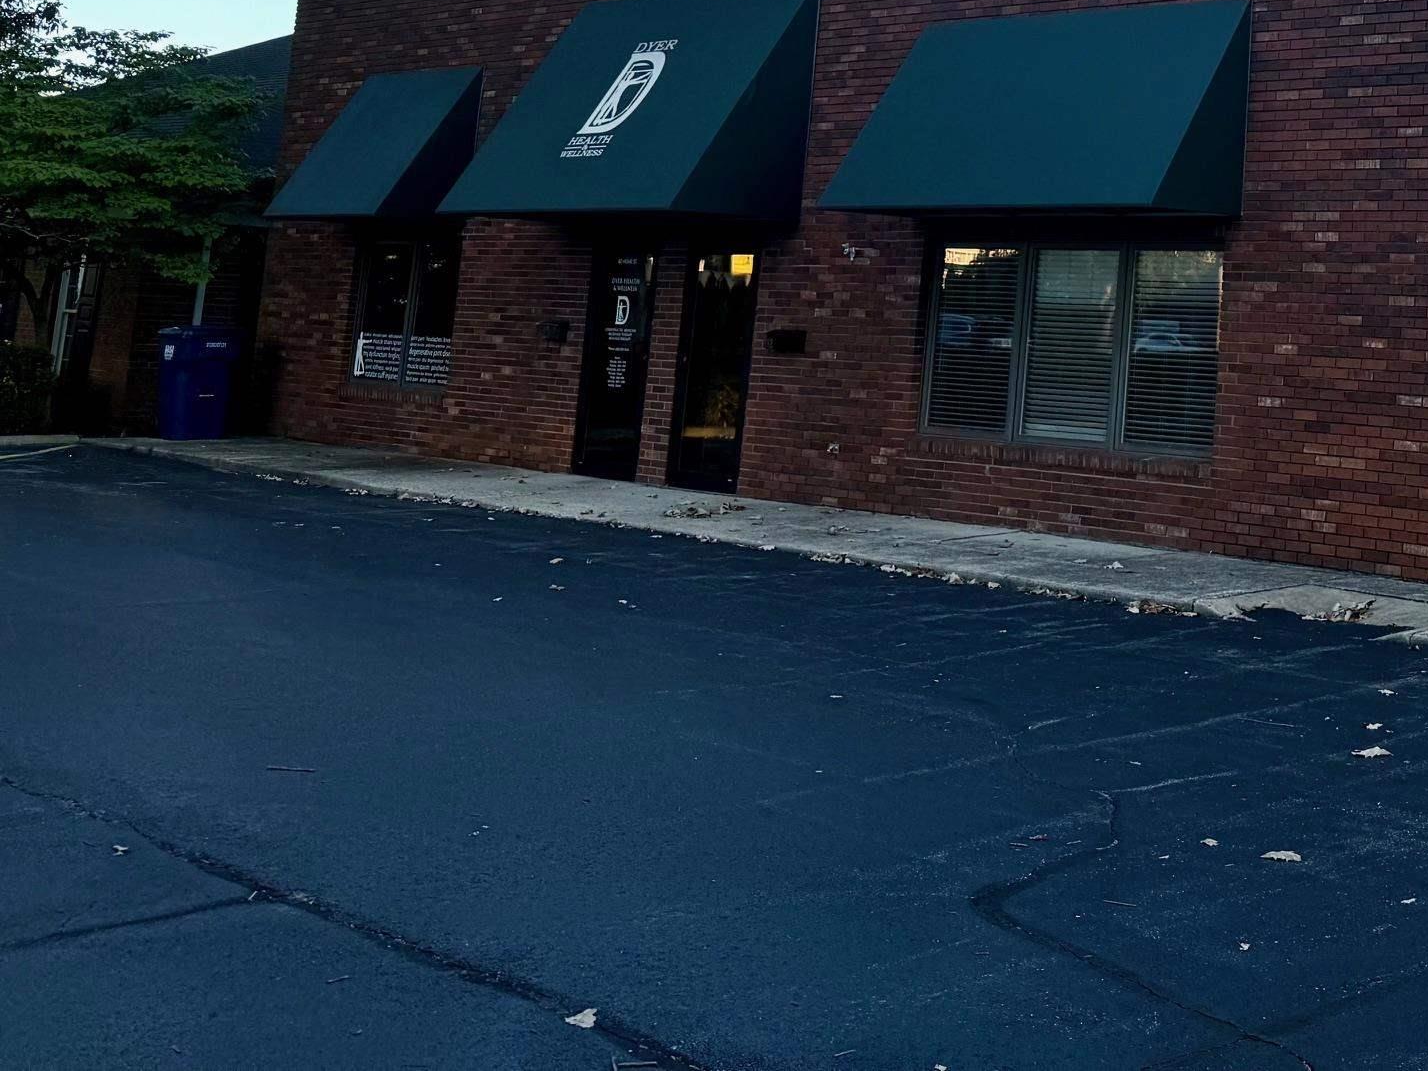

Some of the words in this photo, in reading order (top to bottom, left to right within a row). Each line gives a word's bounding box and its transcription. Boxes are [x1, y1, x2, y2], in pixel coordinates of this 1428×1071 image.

[633, 39, 678, 54] DYER
[568, 135, 613, 145] HEALTH
[560, 149, 604, 158] WELLNESS
